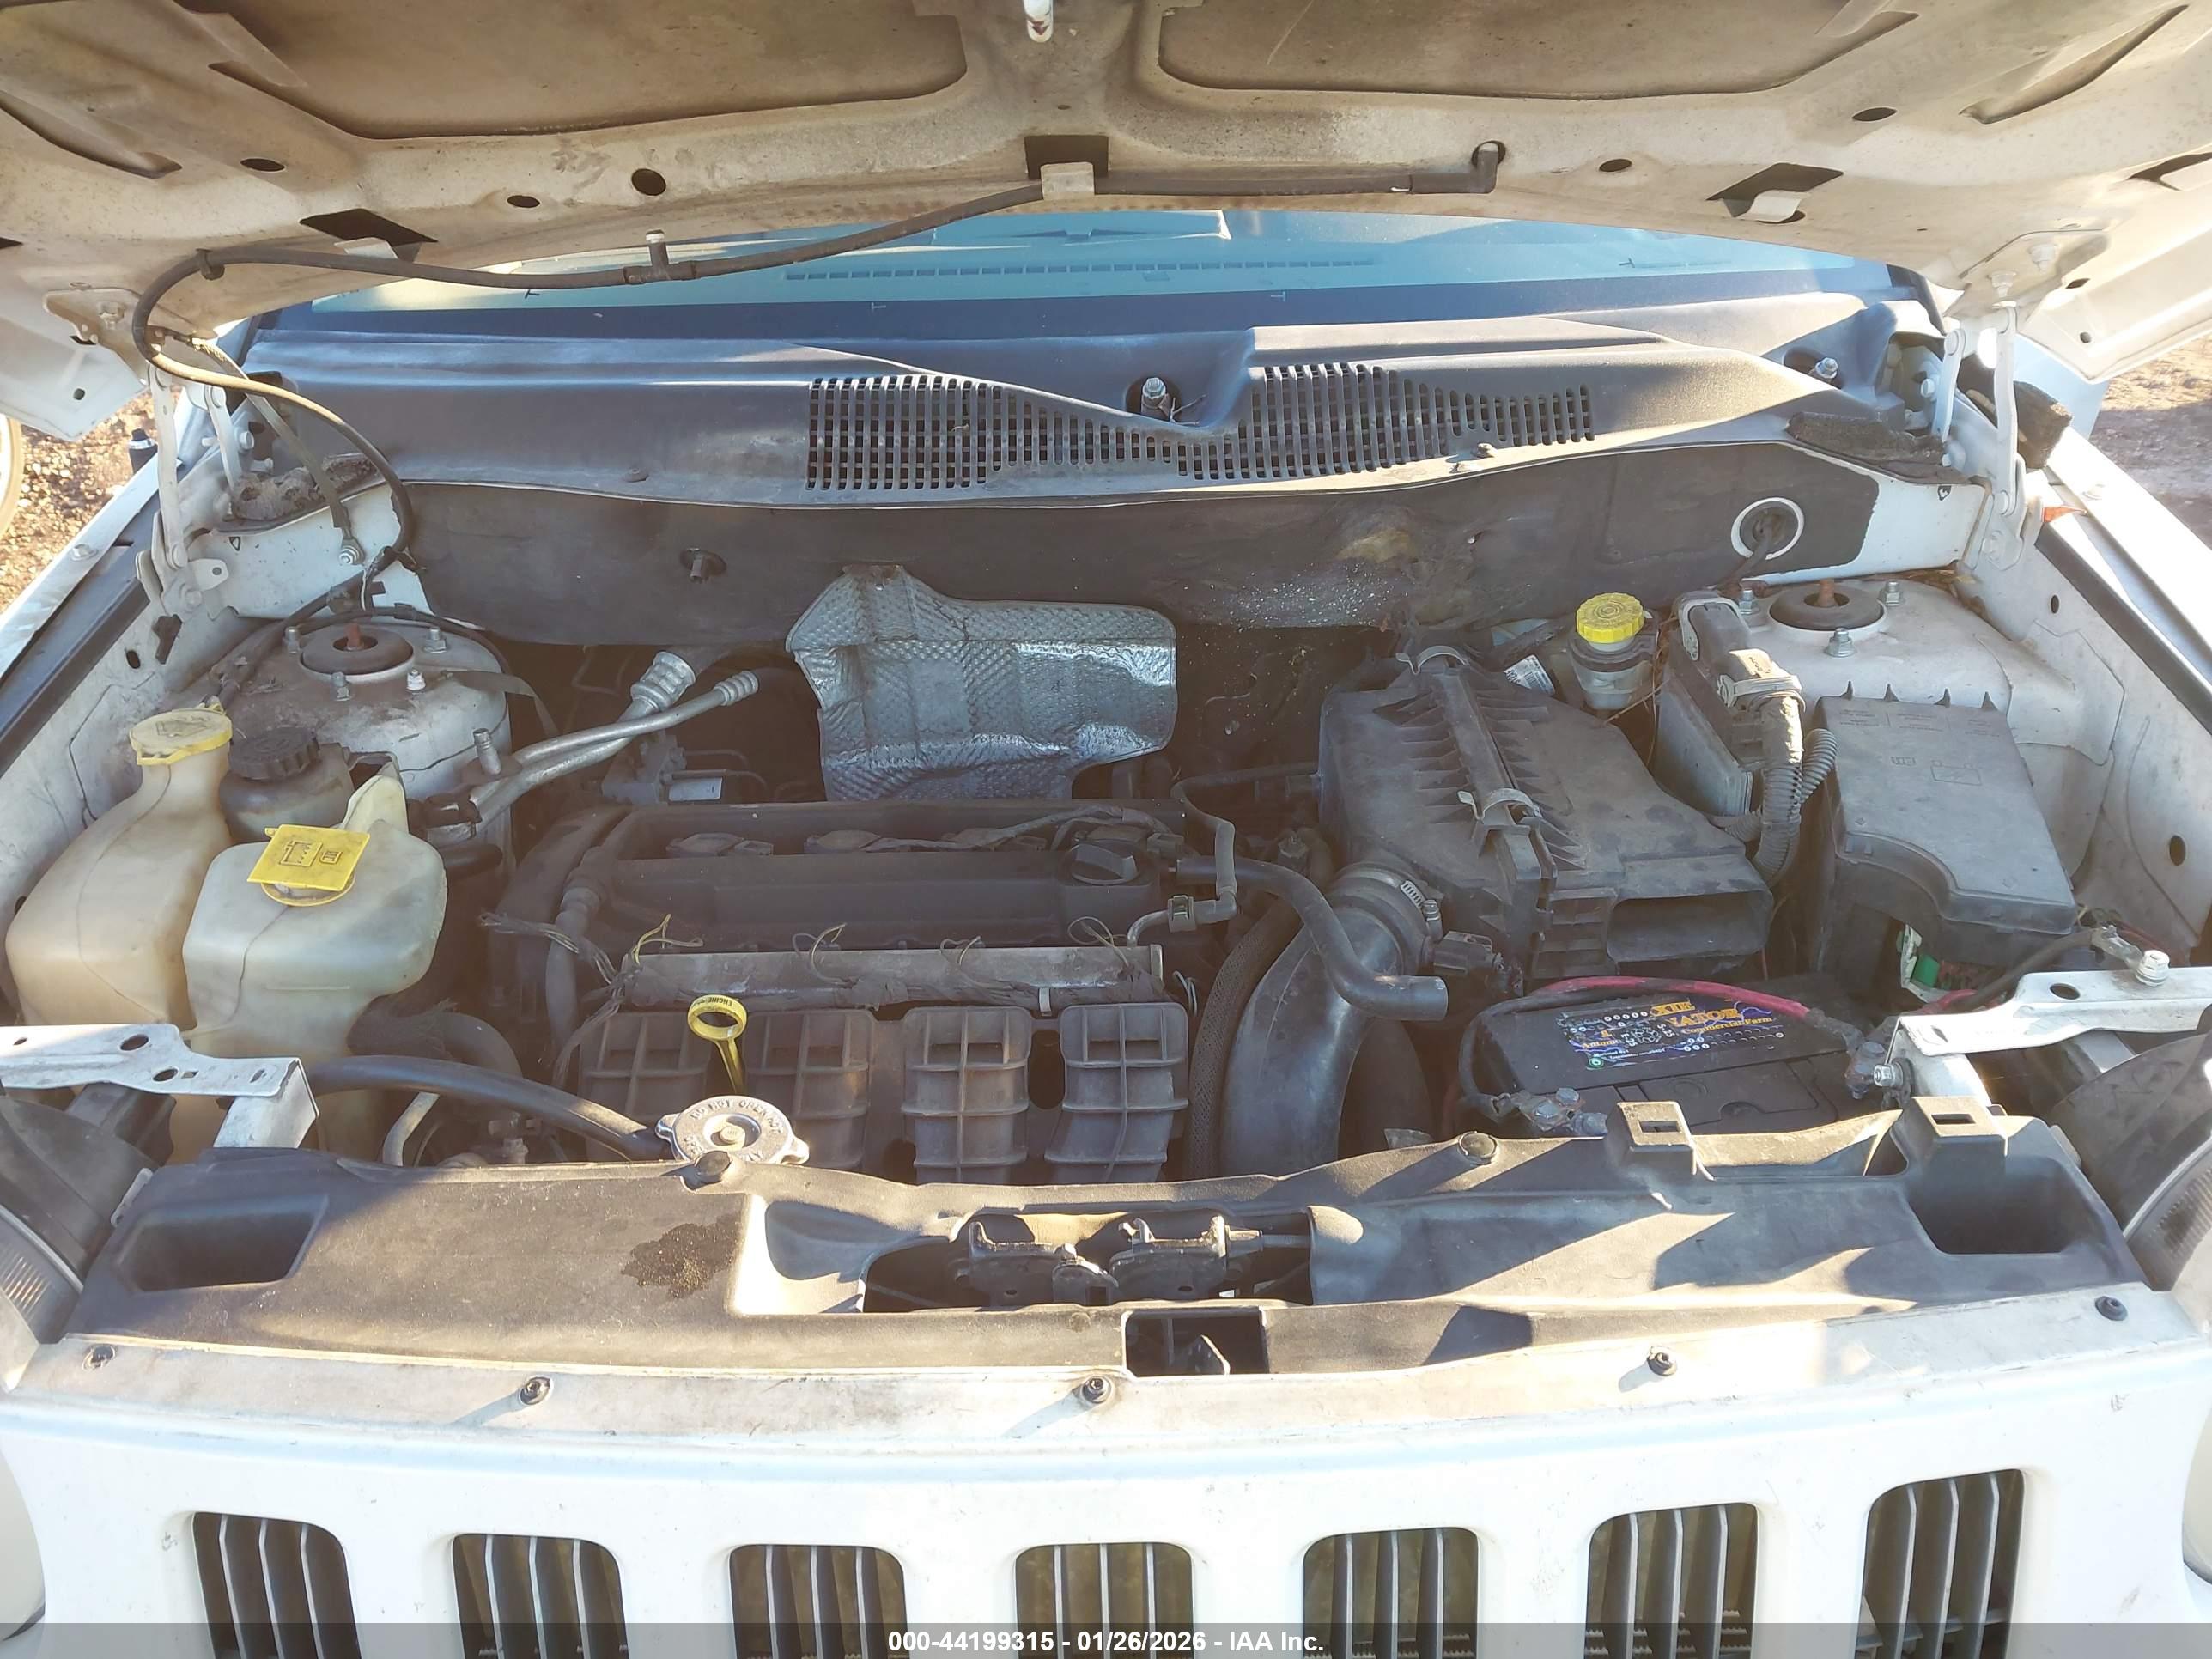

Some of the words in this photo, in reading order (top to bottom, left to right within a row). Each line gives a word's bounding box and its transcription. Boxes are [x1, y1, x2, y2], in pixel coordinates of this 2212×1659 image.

[708, 996, 733, 1006] ENGINE
[690, 1109, 708, 1120] DO
[708, 1099, 734, 1110] NOT
[738, 1099, 767, 1116] OPEN
